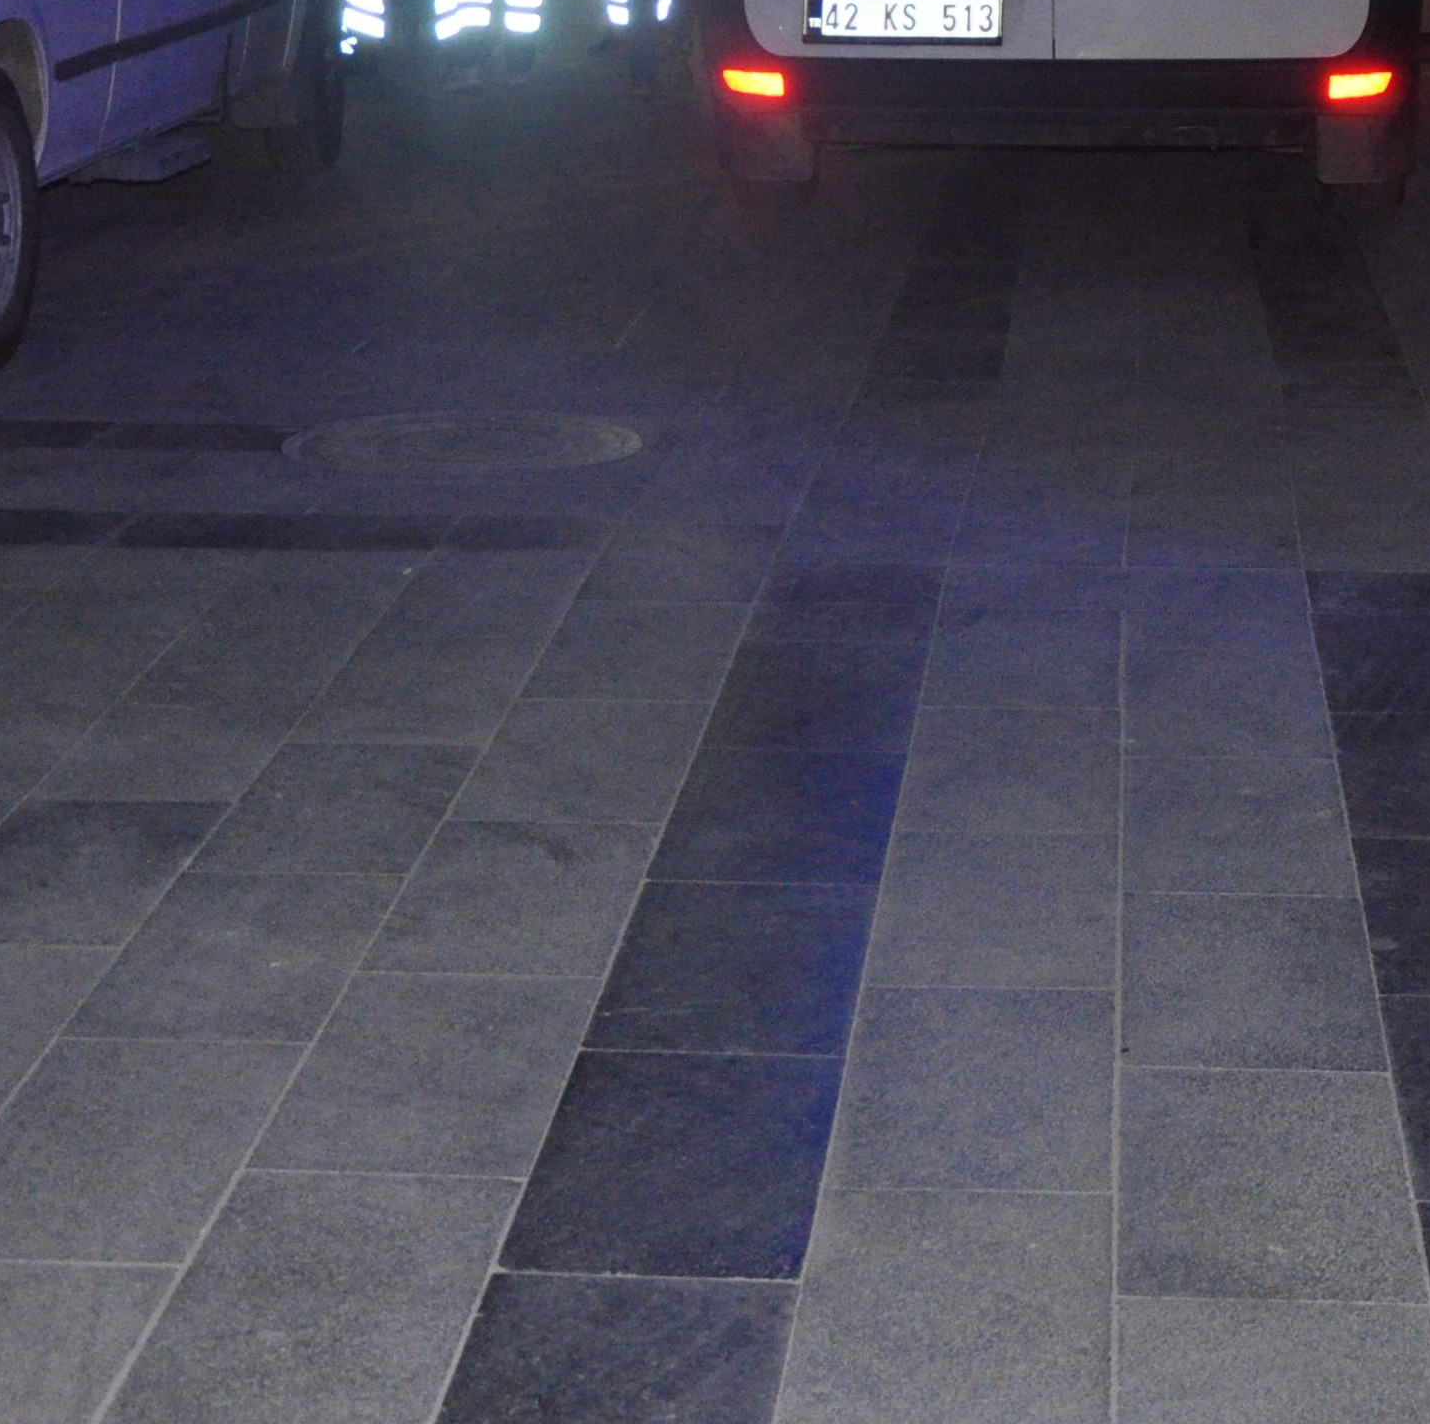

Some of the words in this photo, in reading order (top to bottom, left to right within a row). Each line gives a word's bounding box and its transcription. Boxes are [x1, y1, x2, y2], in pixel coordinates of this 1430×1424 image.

[825, 2, 859, 31] 42
[883, 3, 917, 31] KS
[942, 4, 994, 32] 513
